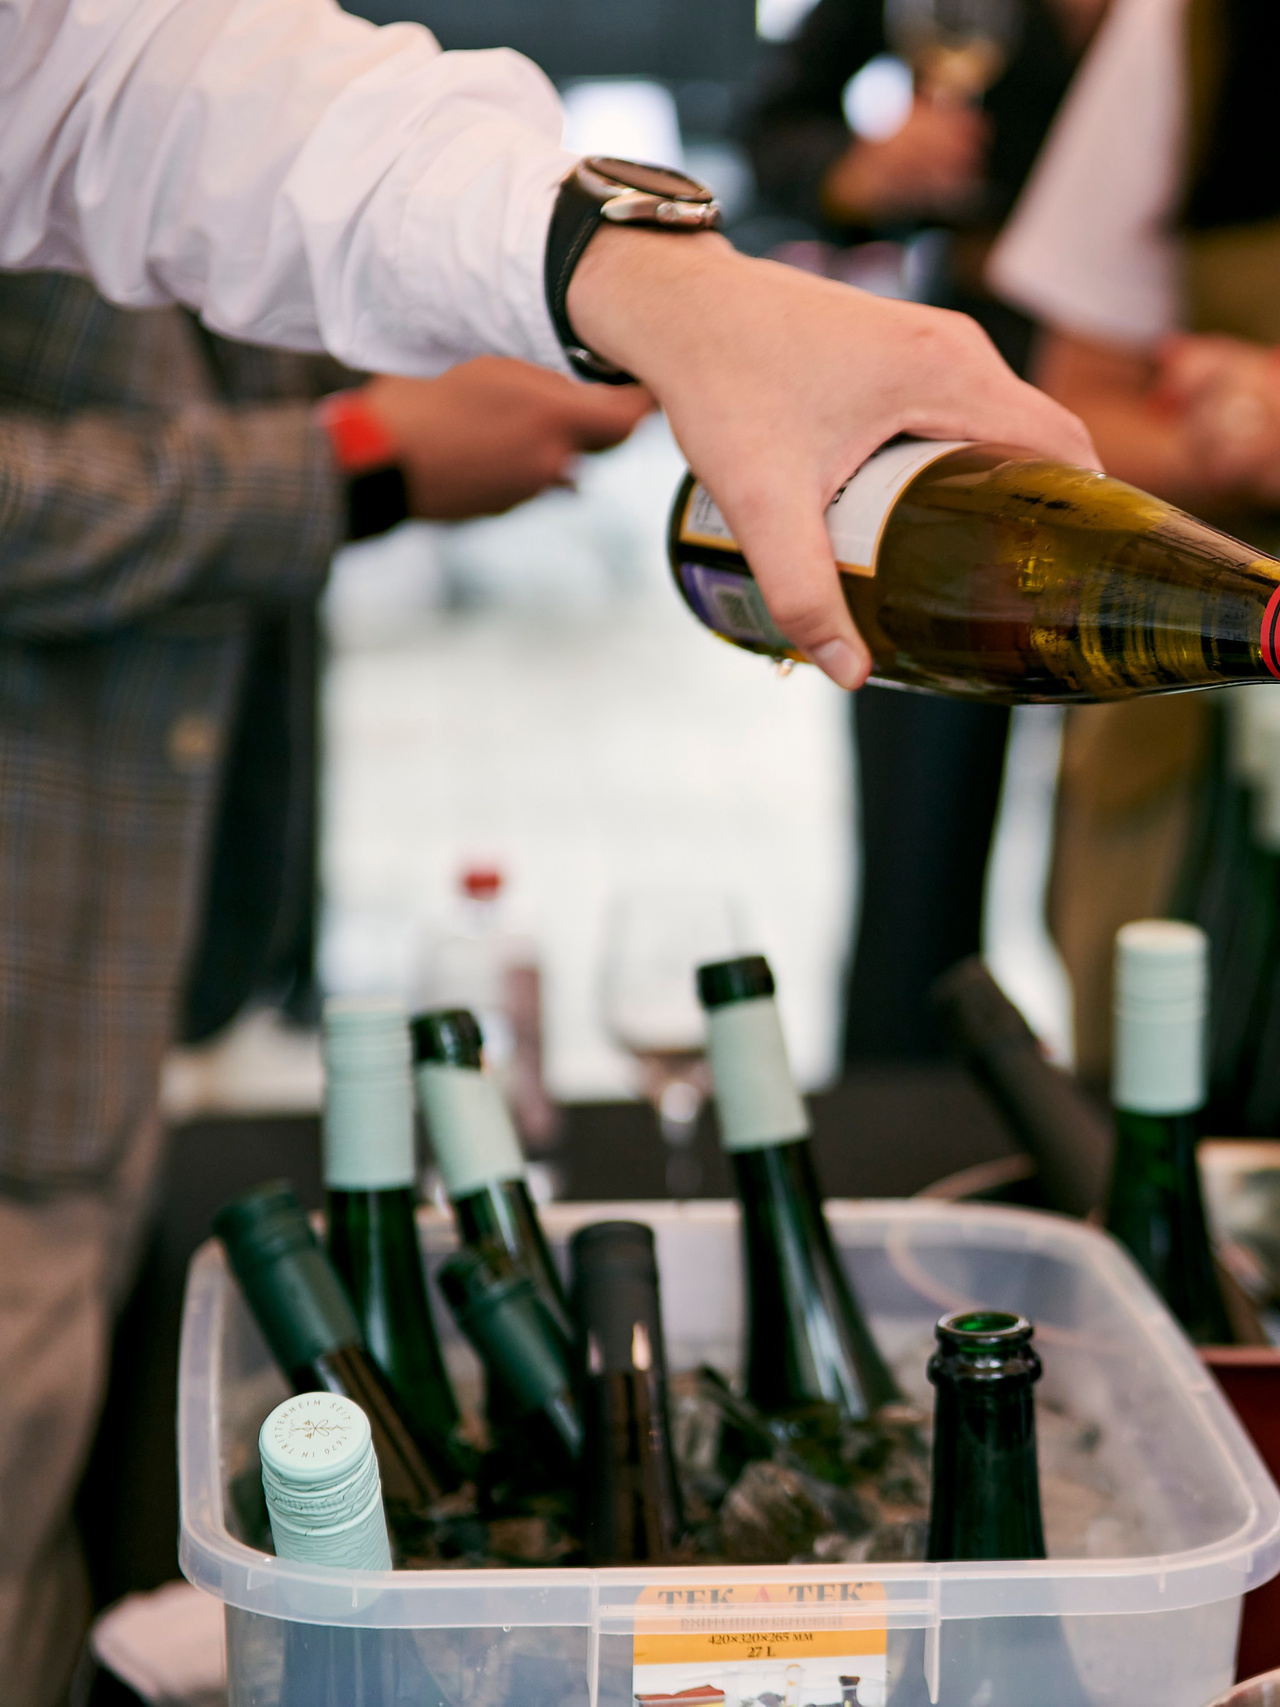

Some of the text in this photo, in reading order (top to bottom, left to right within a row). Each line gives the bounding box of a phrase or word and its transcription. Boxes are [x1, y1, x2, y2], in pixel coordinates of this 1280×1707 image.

[330, 1402, 351, 1421] SEIT
[274, 1400, 321, 1454] TRITTENHEIM
[324, 1436, 348, 1455] 1670
[746, 1646, 763, 1658] 27
